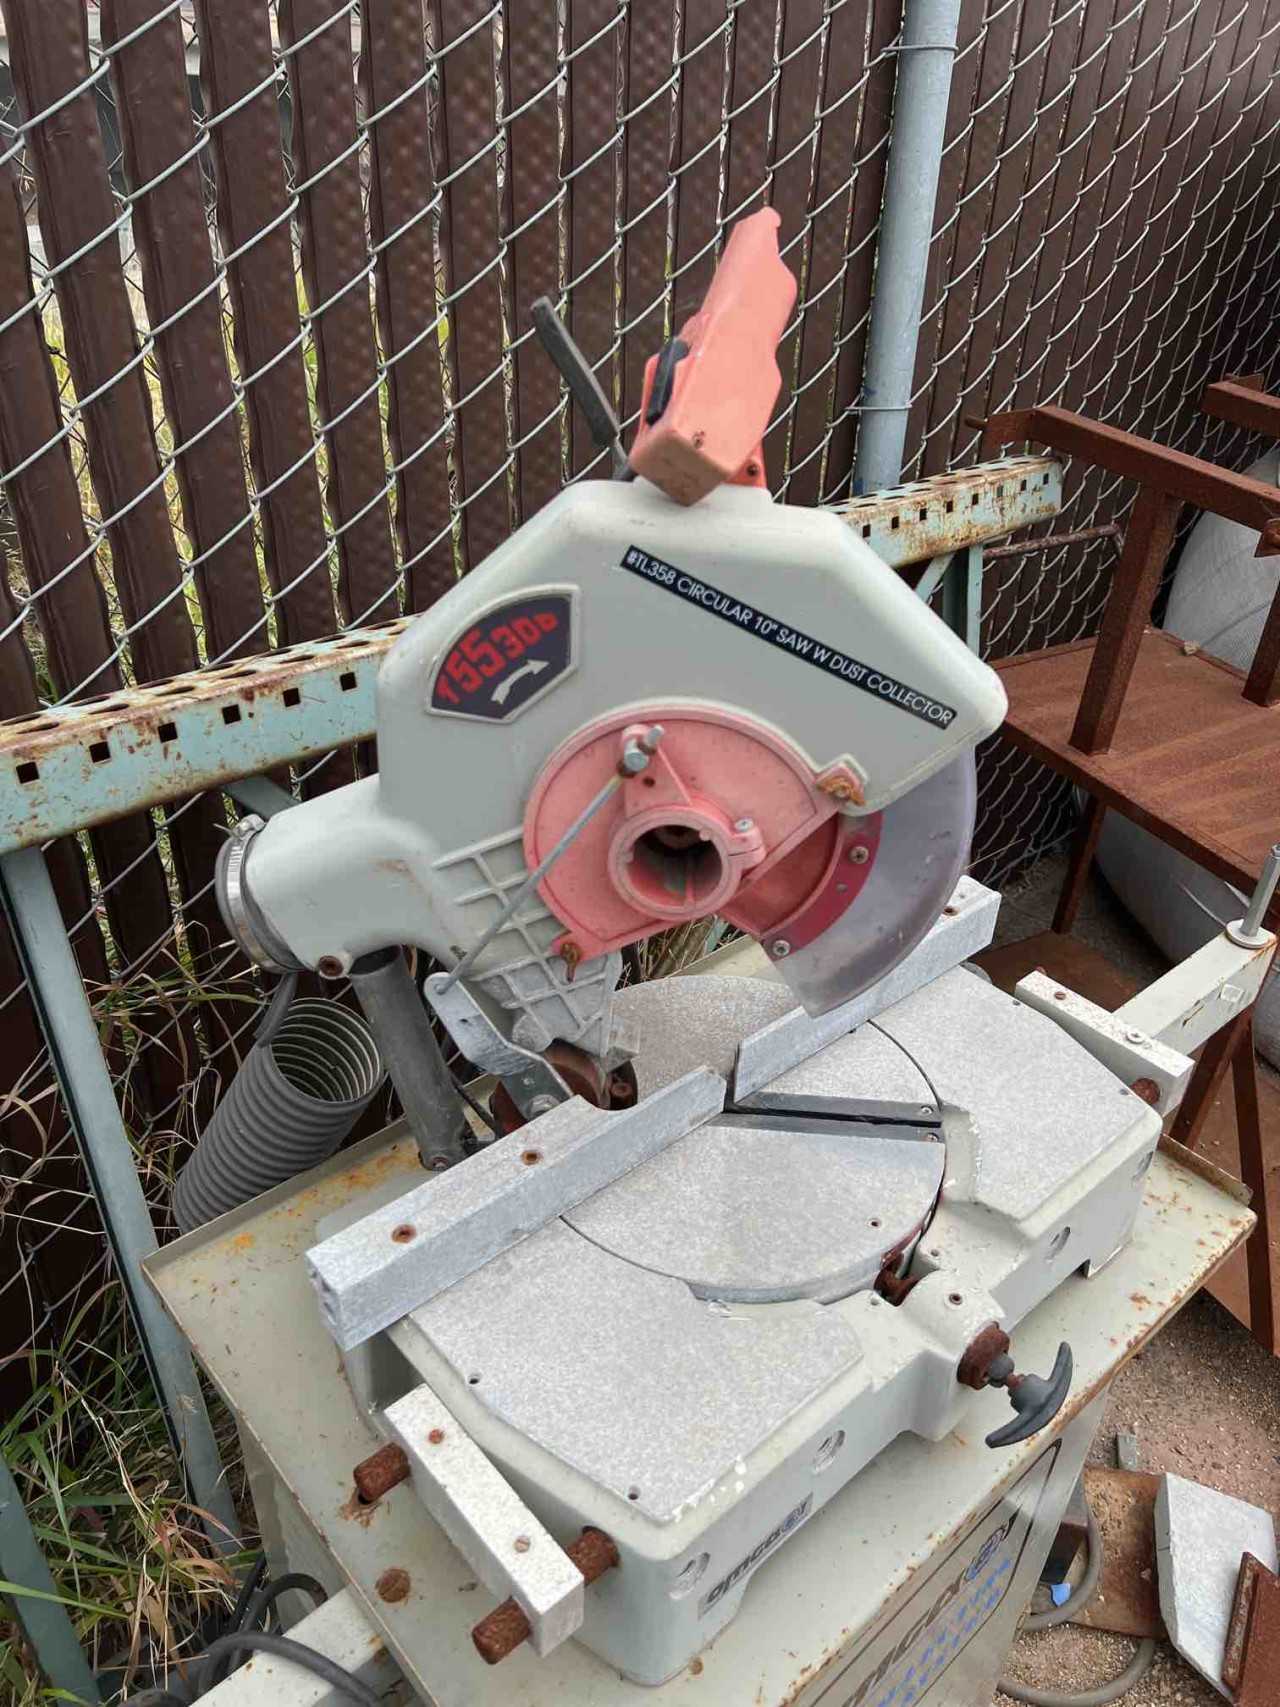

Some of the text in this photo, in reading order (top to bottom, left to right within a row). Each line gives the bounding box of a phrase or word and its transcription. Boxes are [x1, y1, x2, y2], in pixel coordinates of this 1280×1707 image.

[627, 549, 954, 726] #TL358 CIRCULAR 10" SAW W DUST COLLECTOR
